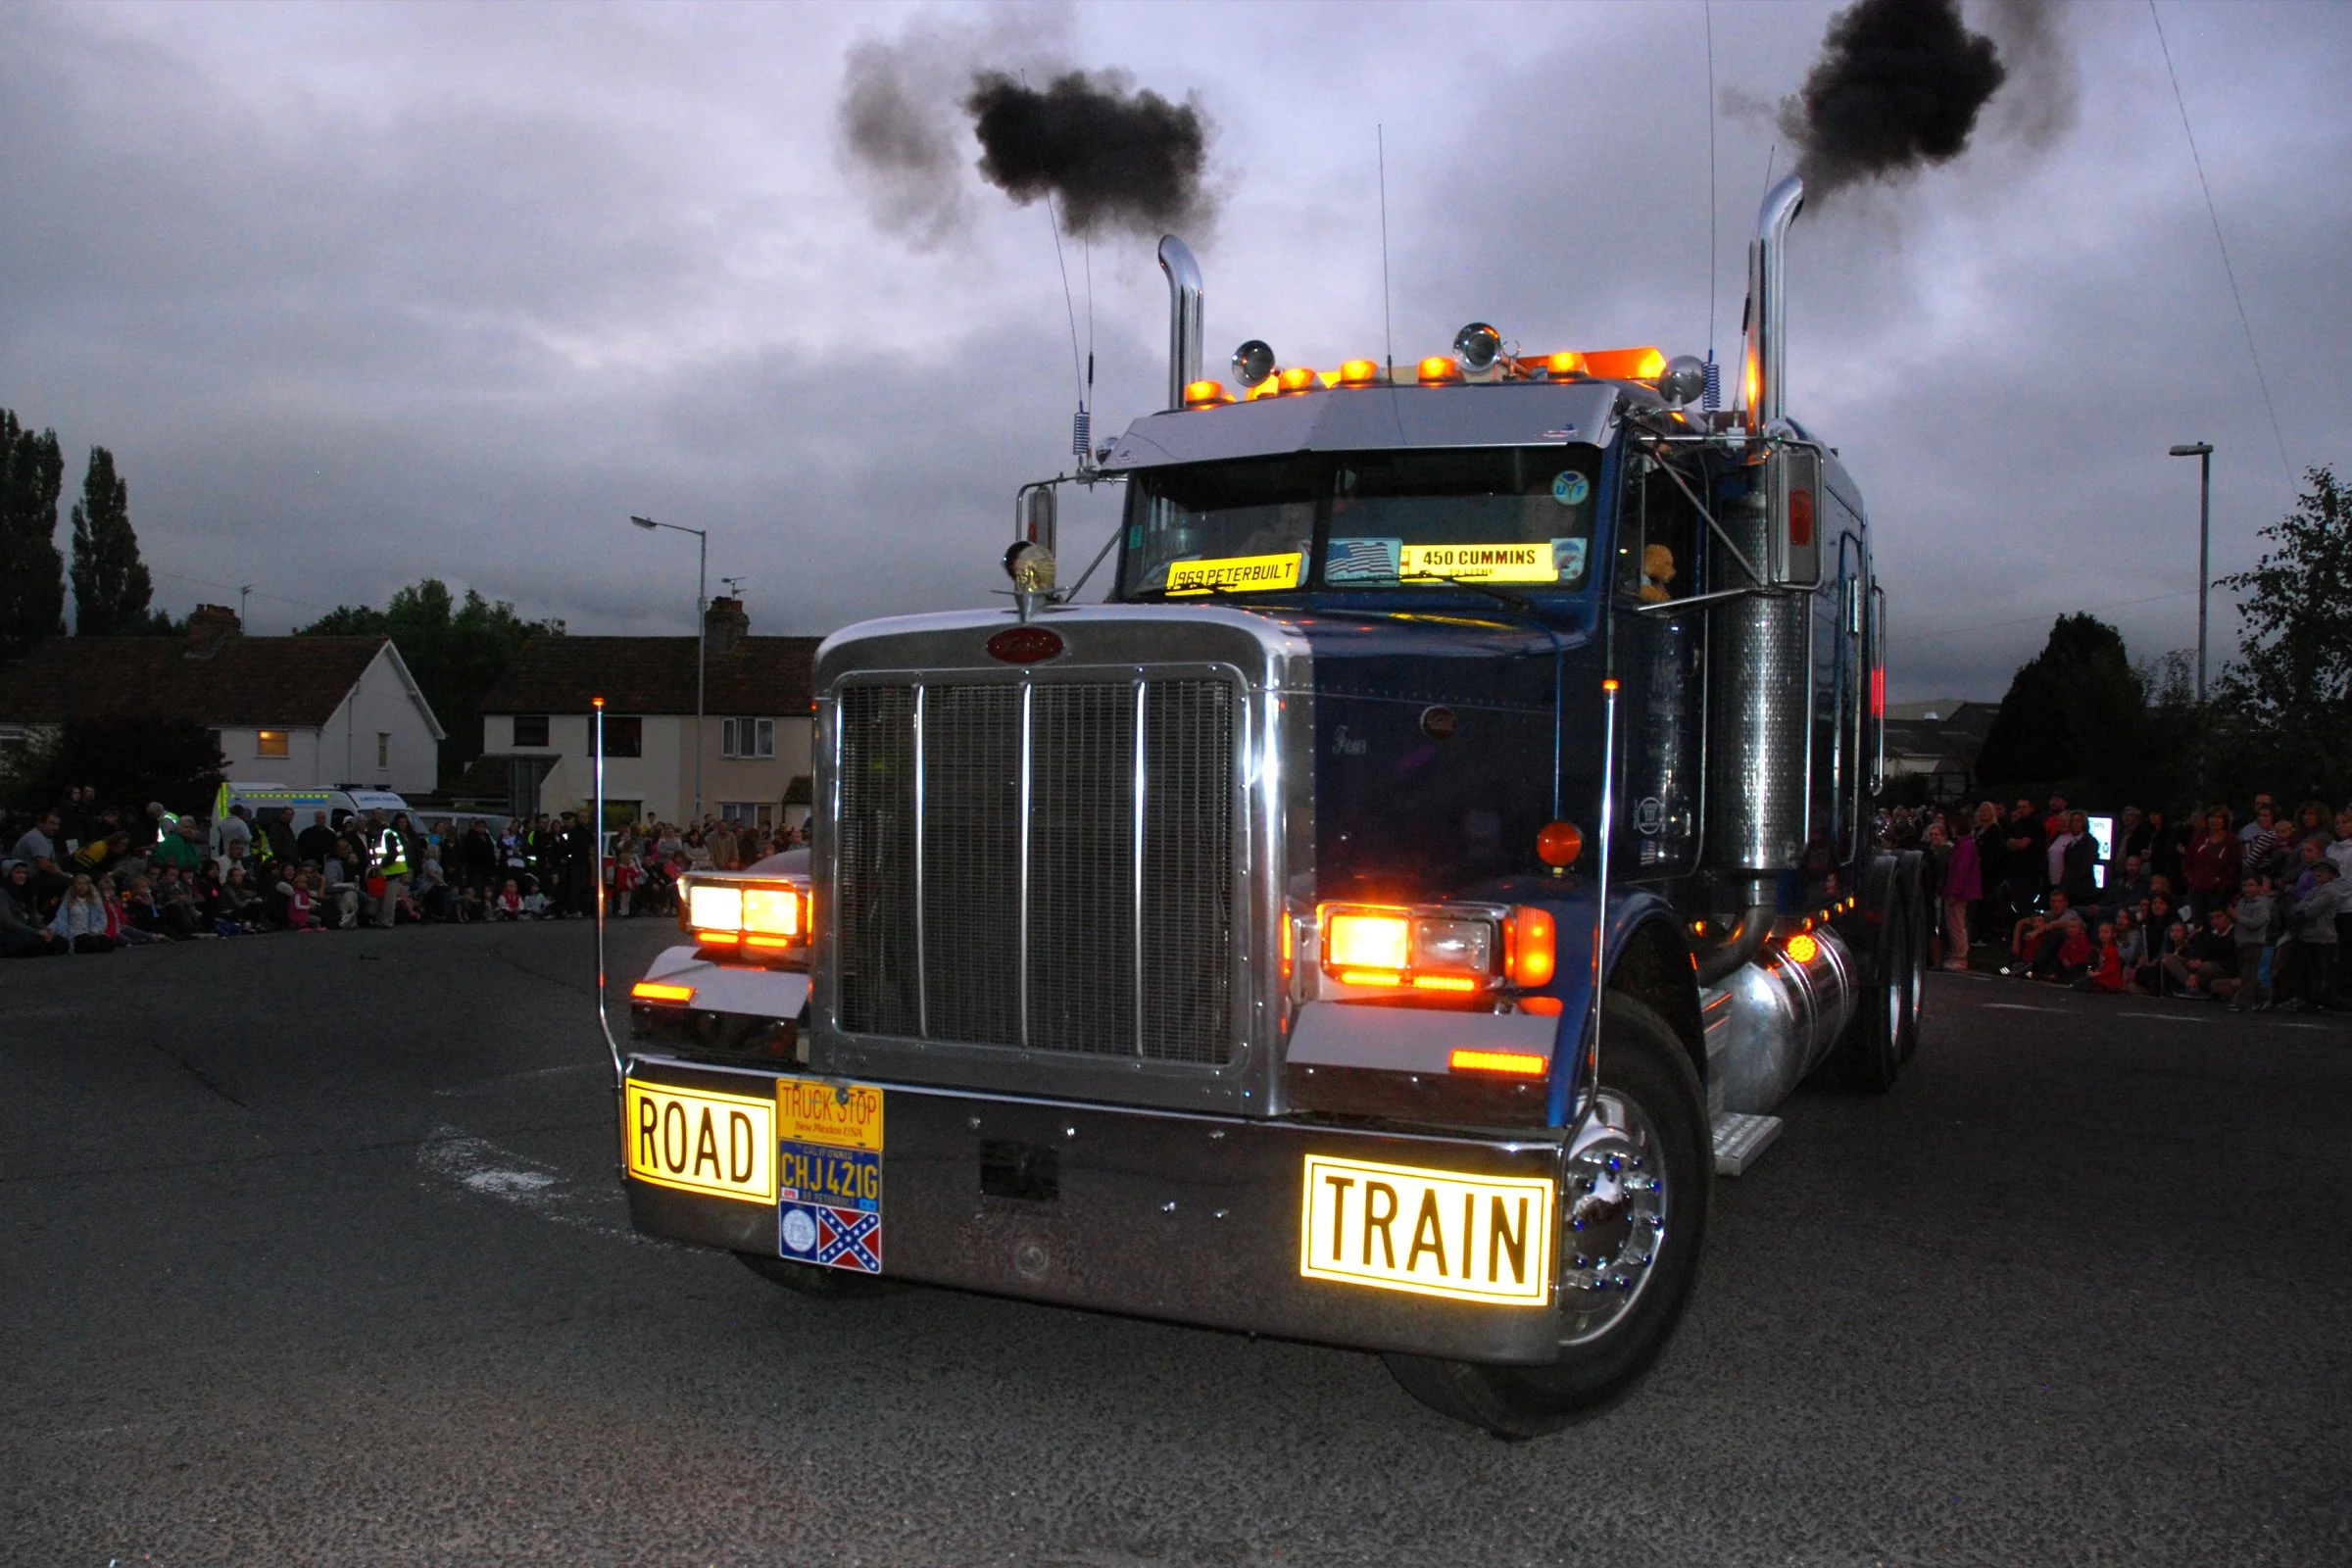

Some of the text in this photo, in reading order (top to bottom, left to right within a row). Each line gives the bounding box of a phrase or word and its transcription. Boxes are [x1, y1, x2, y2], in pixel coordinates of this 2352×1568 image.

[1423, 550, 1536, 565] 450 CUMMINS
[1173, 563, 1294, 586] 1969 PETERBUILT
[784, 1087, 877, 1126] TRUCK STOP
[640, 1096, 753, 1184] ROAD
[844, 1128, 863, 1137] USA
[1325, 1175, 1528, 1284] TRAIN
